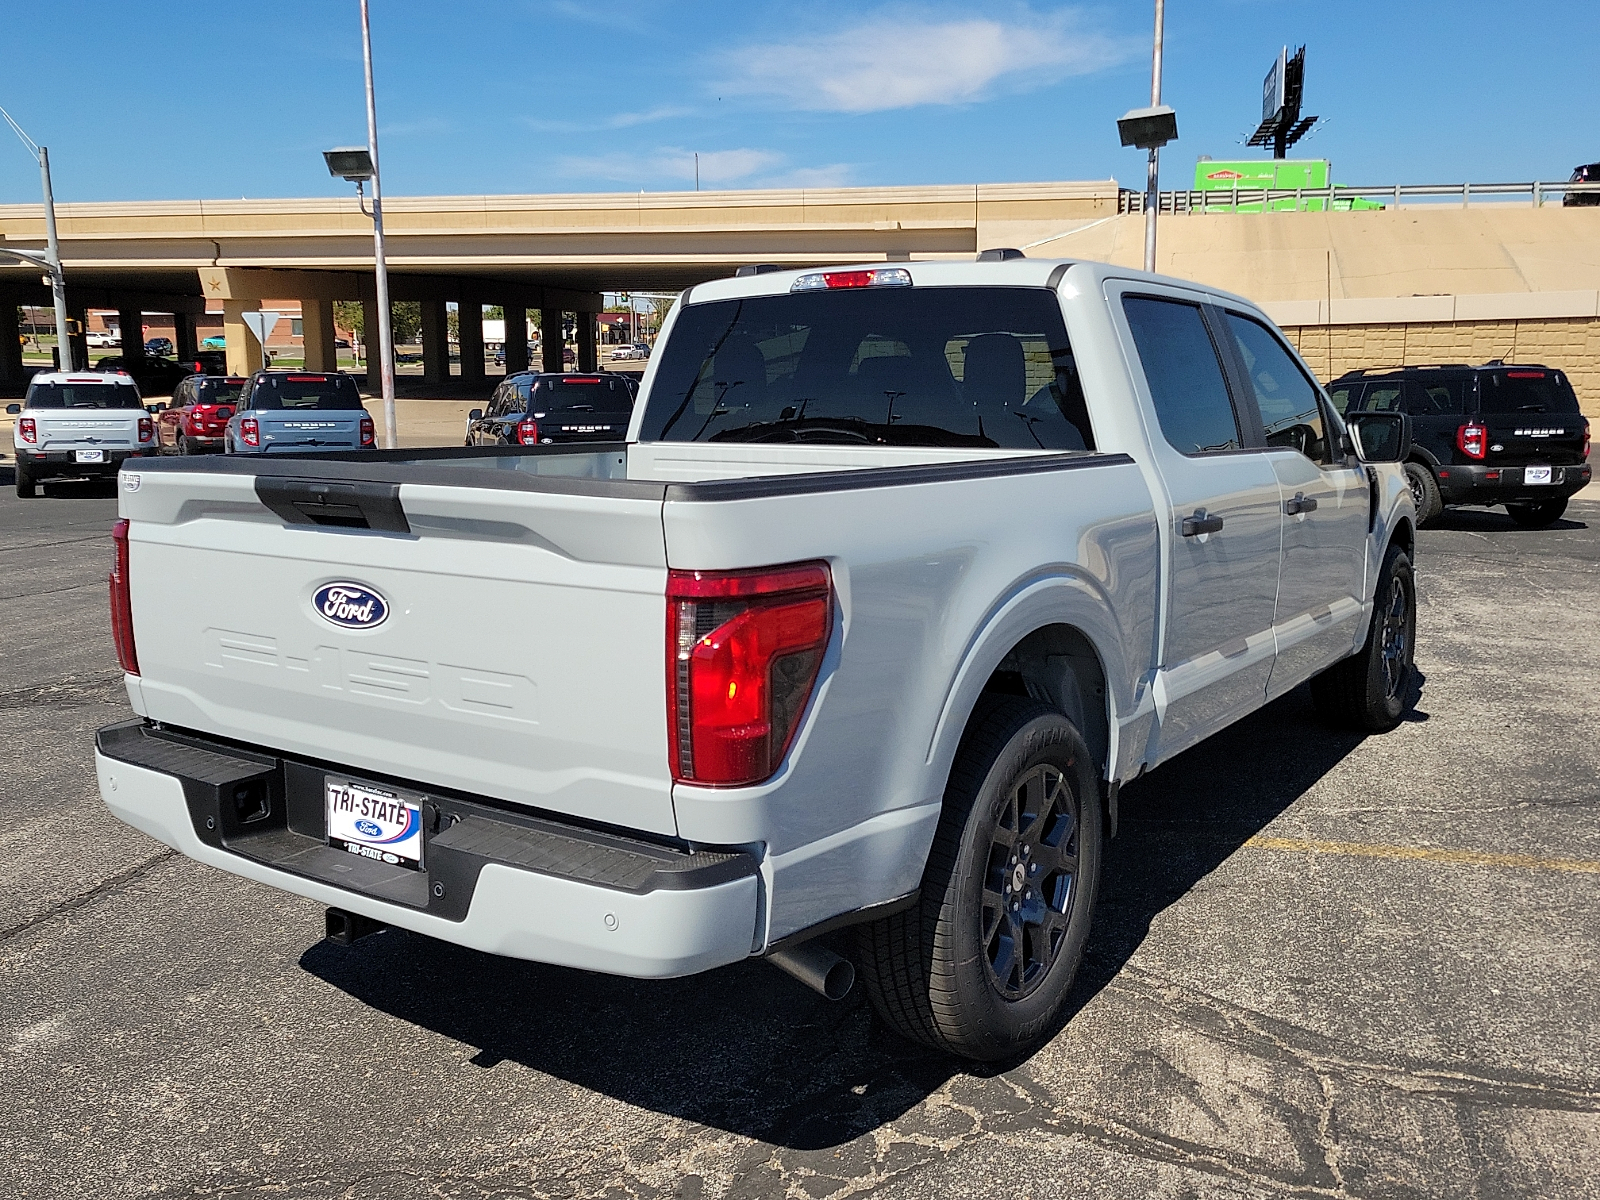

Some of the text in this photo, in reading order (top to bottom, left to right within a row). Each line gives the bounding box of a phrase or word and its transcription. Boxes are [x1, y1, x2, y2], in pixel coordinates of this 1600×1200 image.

[323, 587, 374, 622] Ford
[201, 626, 539, 725] F-150
[330, 788, 405, 826] TRI-STATE
[359, 821, 379, 836] Ford
